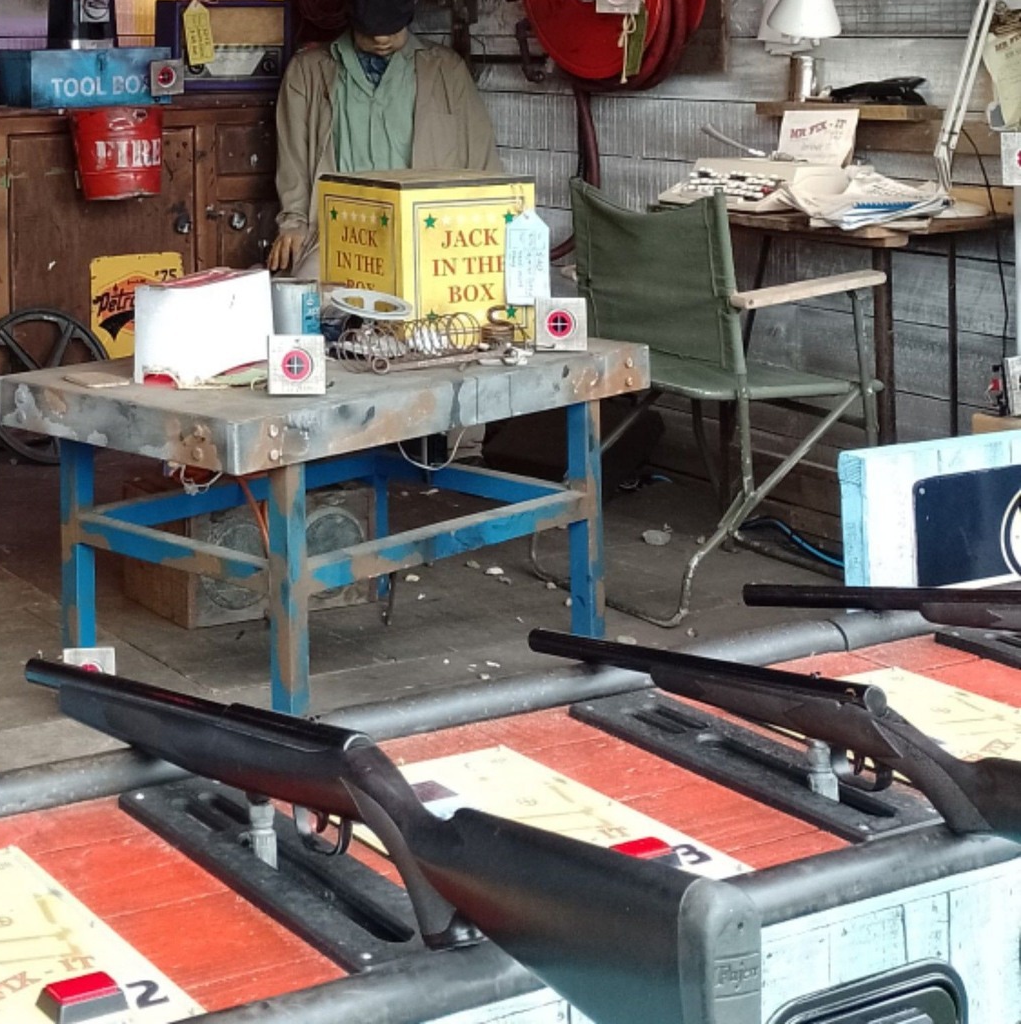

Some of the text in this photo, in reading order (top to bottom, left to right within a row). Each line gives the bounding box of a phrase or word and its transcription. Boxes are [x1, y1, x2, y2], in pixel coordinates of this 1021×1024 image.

[51, 74, 151, 97] TOOL BOX
[94, 138, 161, 170] FIRE
[341, 226, 377, 248] JACK
[441, 228, 499, 249] JACK
[336, 250, 384, 277] IN THE
[432, 255, 505, 277] IN THE
[448, 283, 496, 304] BOX
[671, 843, 713, 865] 3
[58, 955, 96, 972] IT
[125, 979, 170, 1009] 2
